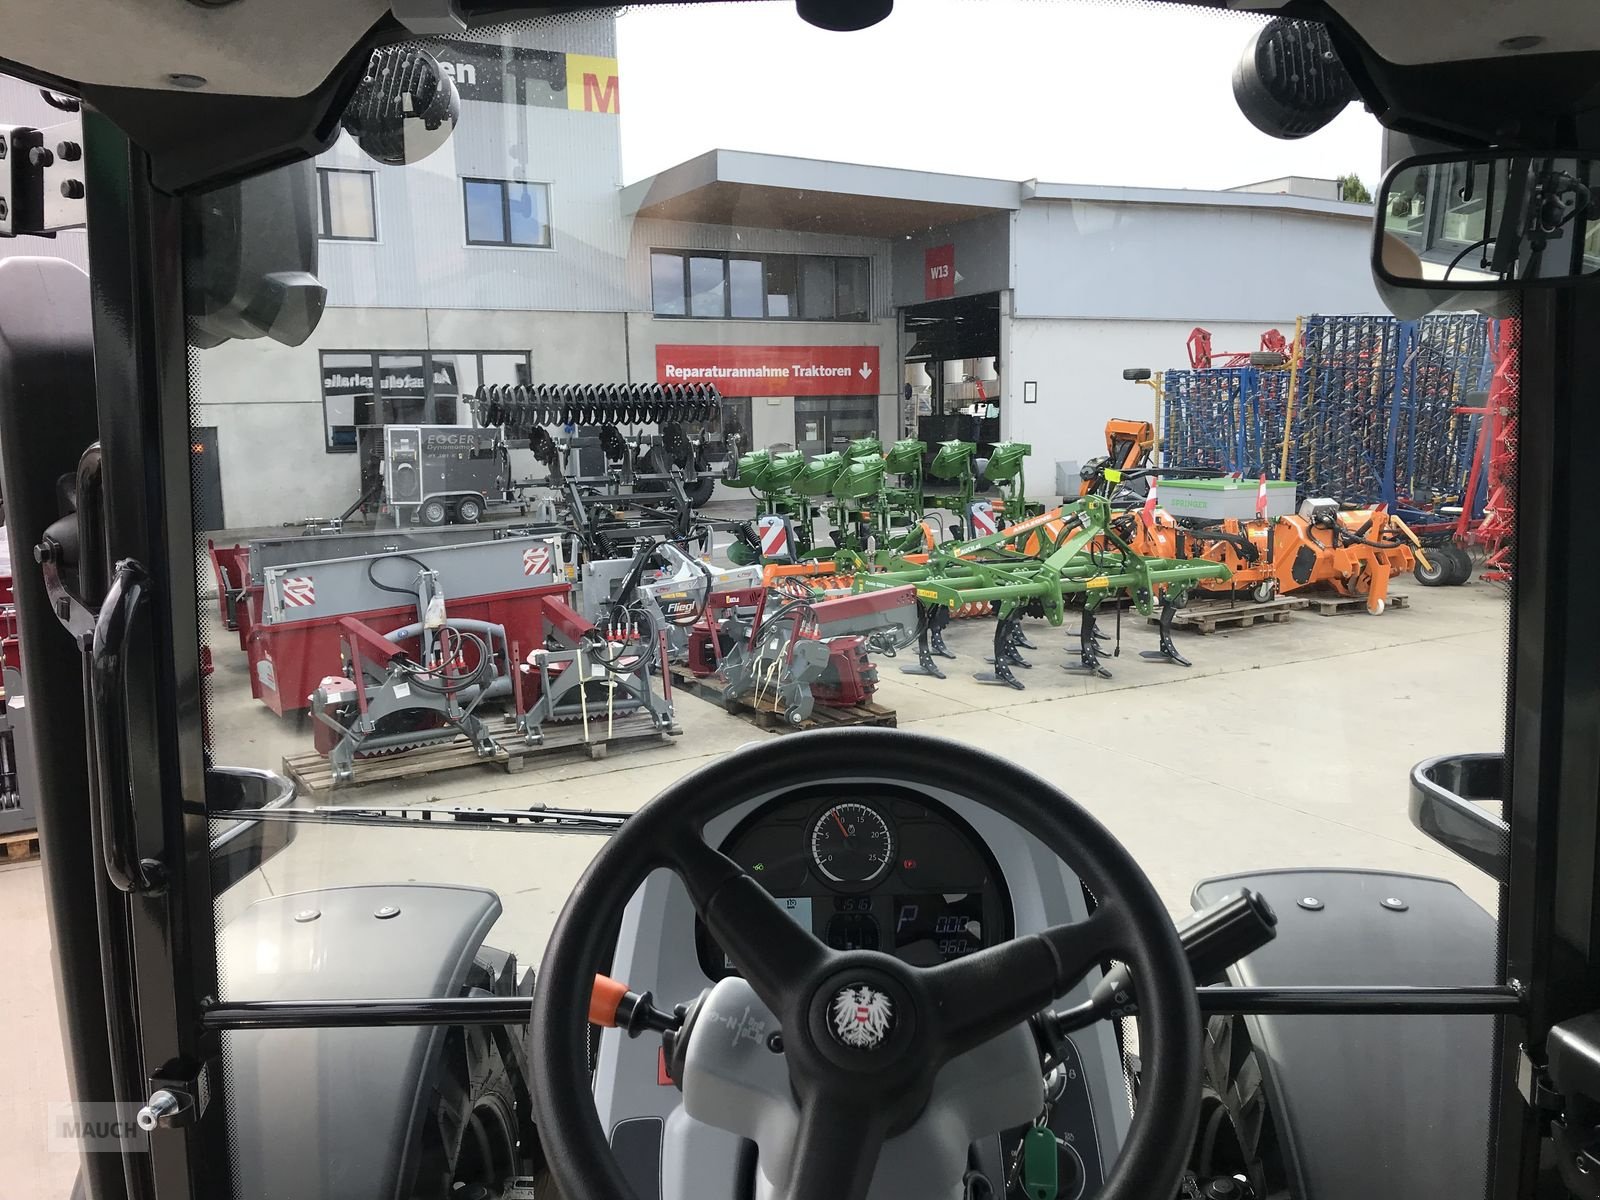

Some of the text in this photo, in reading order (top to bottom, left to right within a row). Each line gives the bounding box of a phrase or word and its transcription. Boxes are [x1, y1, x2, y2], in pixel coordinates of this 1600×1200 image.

[437, 61, 477, 85] en
[930, 264, 949, 280] W13
[665, 363, 852, 380] Reparaturannahme Traktoren
[426, 434, 475, 445] EGGER
[1171, 499, 1208, 509] SPRINGER
[667, 600, 696, 614] Fliegl
[856, 816, 865, 824] 15
[825, 832, 830, 840] 5
[871, 831, 880, 839] 20
[827, 854, 833, 862] 0
